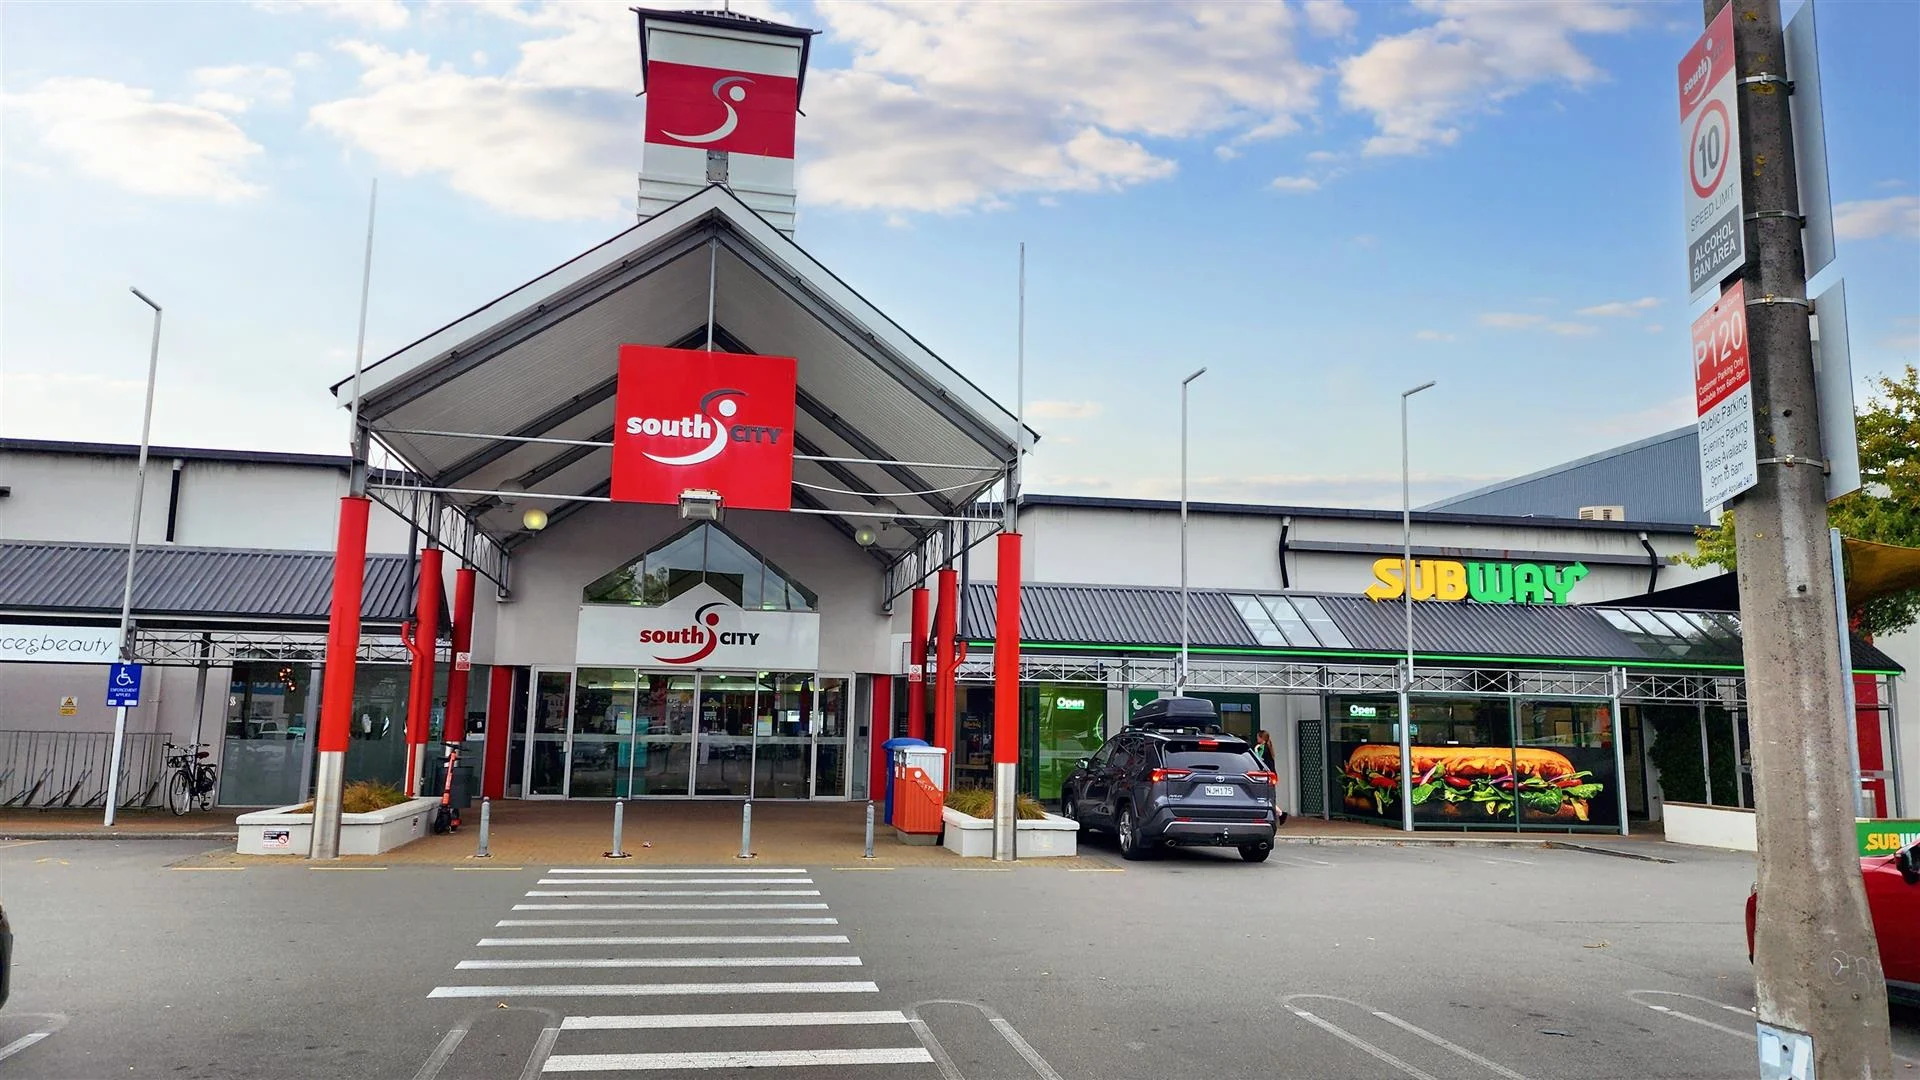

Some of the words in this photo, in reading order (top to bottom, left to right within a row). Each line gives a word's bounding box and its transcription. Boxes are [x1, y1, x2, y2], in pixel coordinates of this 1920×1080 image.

[1683, 57, 1708, 95] south
[1699, 125, 1719, 178] 10
[1690, 202, 1714, 231] SPEED
[1715, 183, 1735, 209] LIMIT
[1694, 222, 1734, 264] ALCOHOL
[1694, 258, 1711, 282] BAN
[1712, 238, 1736, 270] AREA
[1695, 310, 1742, 380] P120
[1718, 365, 1733, 381] Parking
[1734, 356, 1743, 369] Only
[626, 414, 711, 439] south
[731, 425, 782, 444] CITY
[1701, 413, 1720, 434] Public
[1721, 394, 1747, 419] Parking
[1703, 434, 1724, 456] Evening
[1726, 420, 1747, 441] Parking
[1705, 456, 1720, 472] Rates
[1722, 438, 1747, 462] Available
[1711, 475, 1722, 489] 9pm
[1731, 461, 1744, 476] 6am
[1364, 560, 1590, 604] SUBWAY
[640, 626, 704, 644] south
[720, 632, 760, 645] CITY
[1057, 697, 1084, 709] Open
[1350, 704, 1376, 716] Open
[1206, 787, 1233, 795] NJH175
